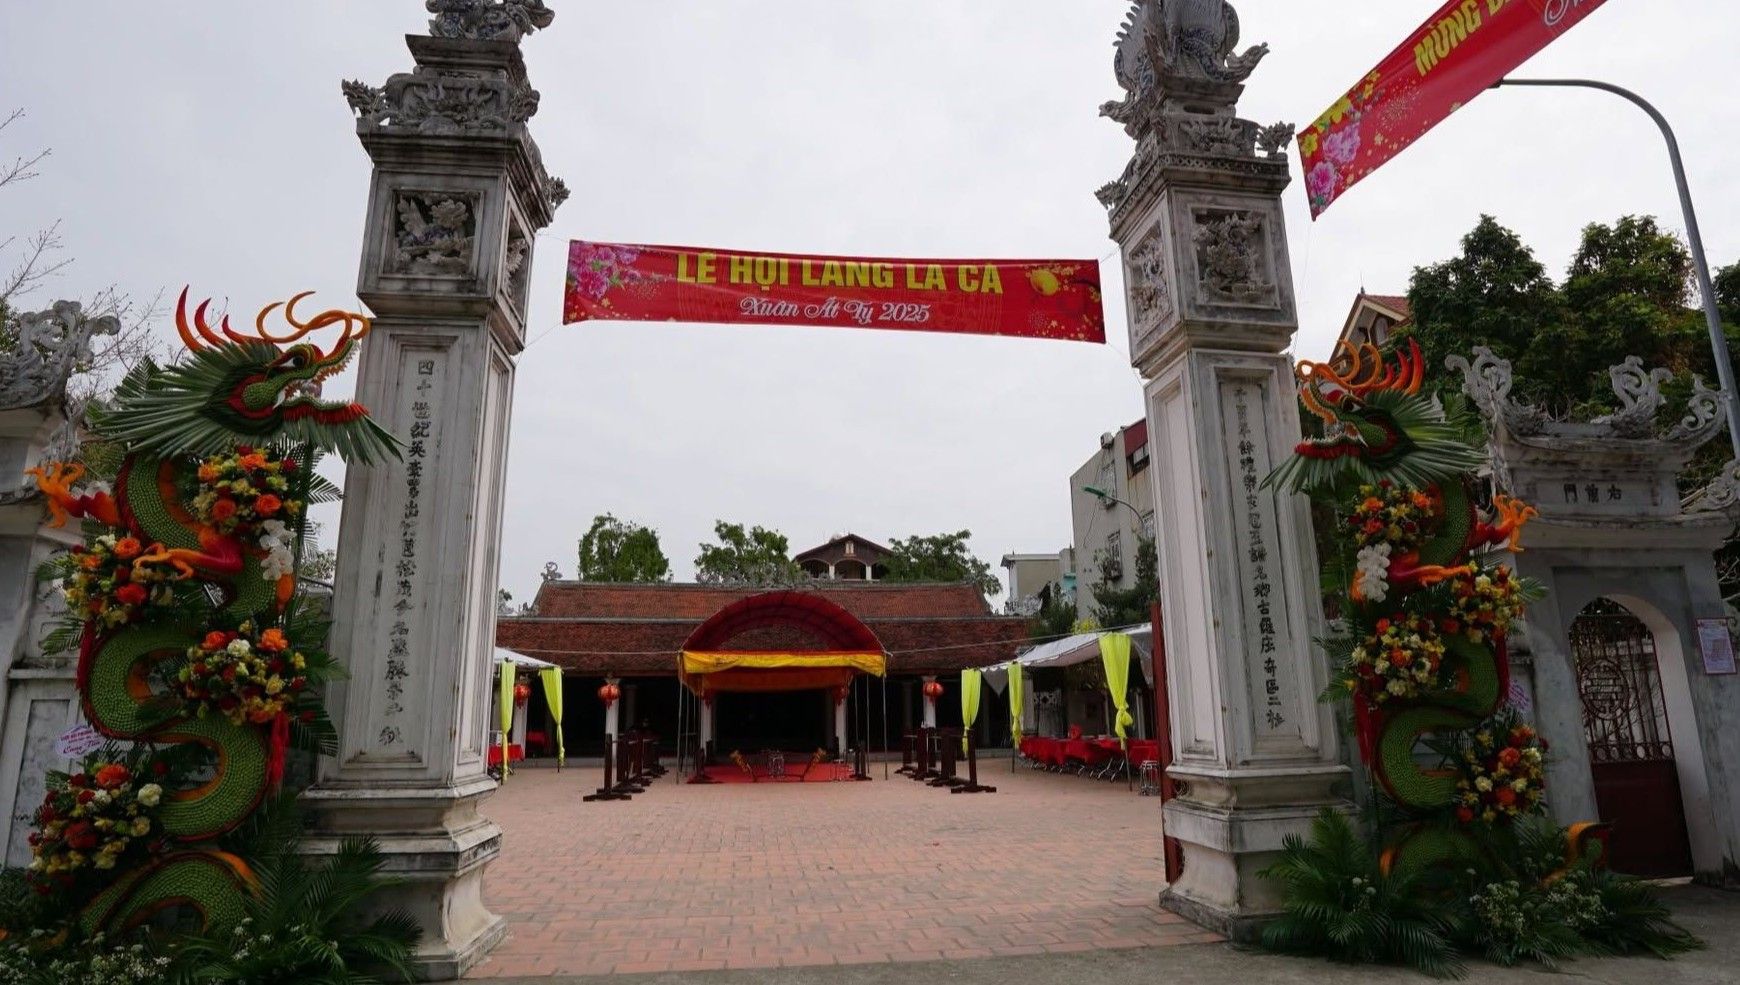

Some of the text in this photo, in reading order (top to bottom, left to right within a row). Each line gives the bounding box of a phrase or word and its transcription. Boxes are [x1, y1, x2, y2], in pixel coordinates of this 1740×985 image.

[907, 263, 947, 292] LA
[740, 296, 799, 317] Xuân
[878, 302, 931, 324] 2025
